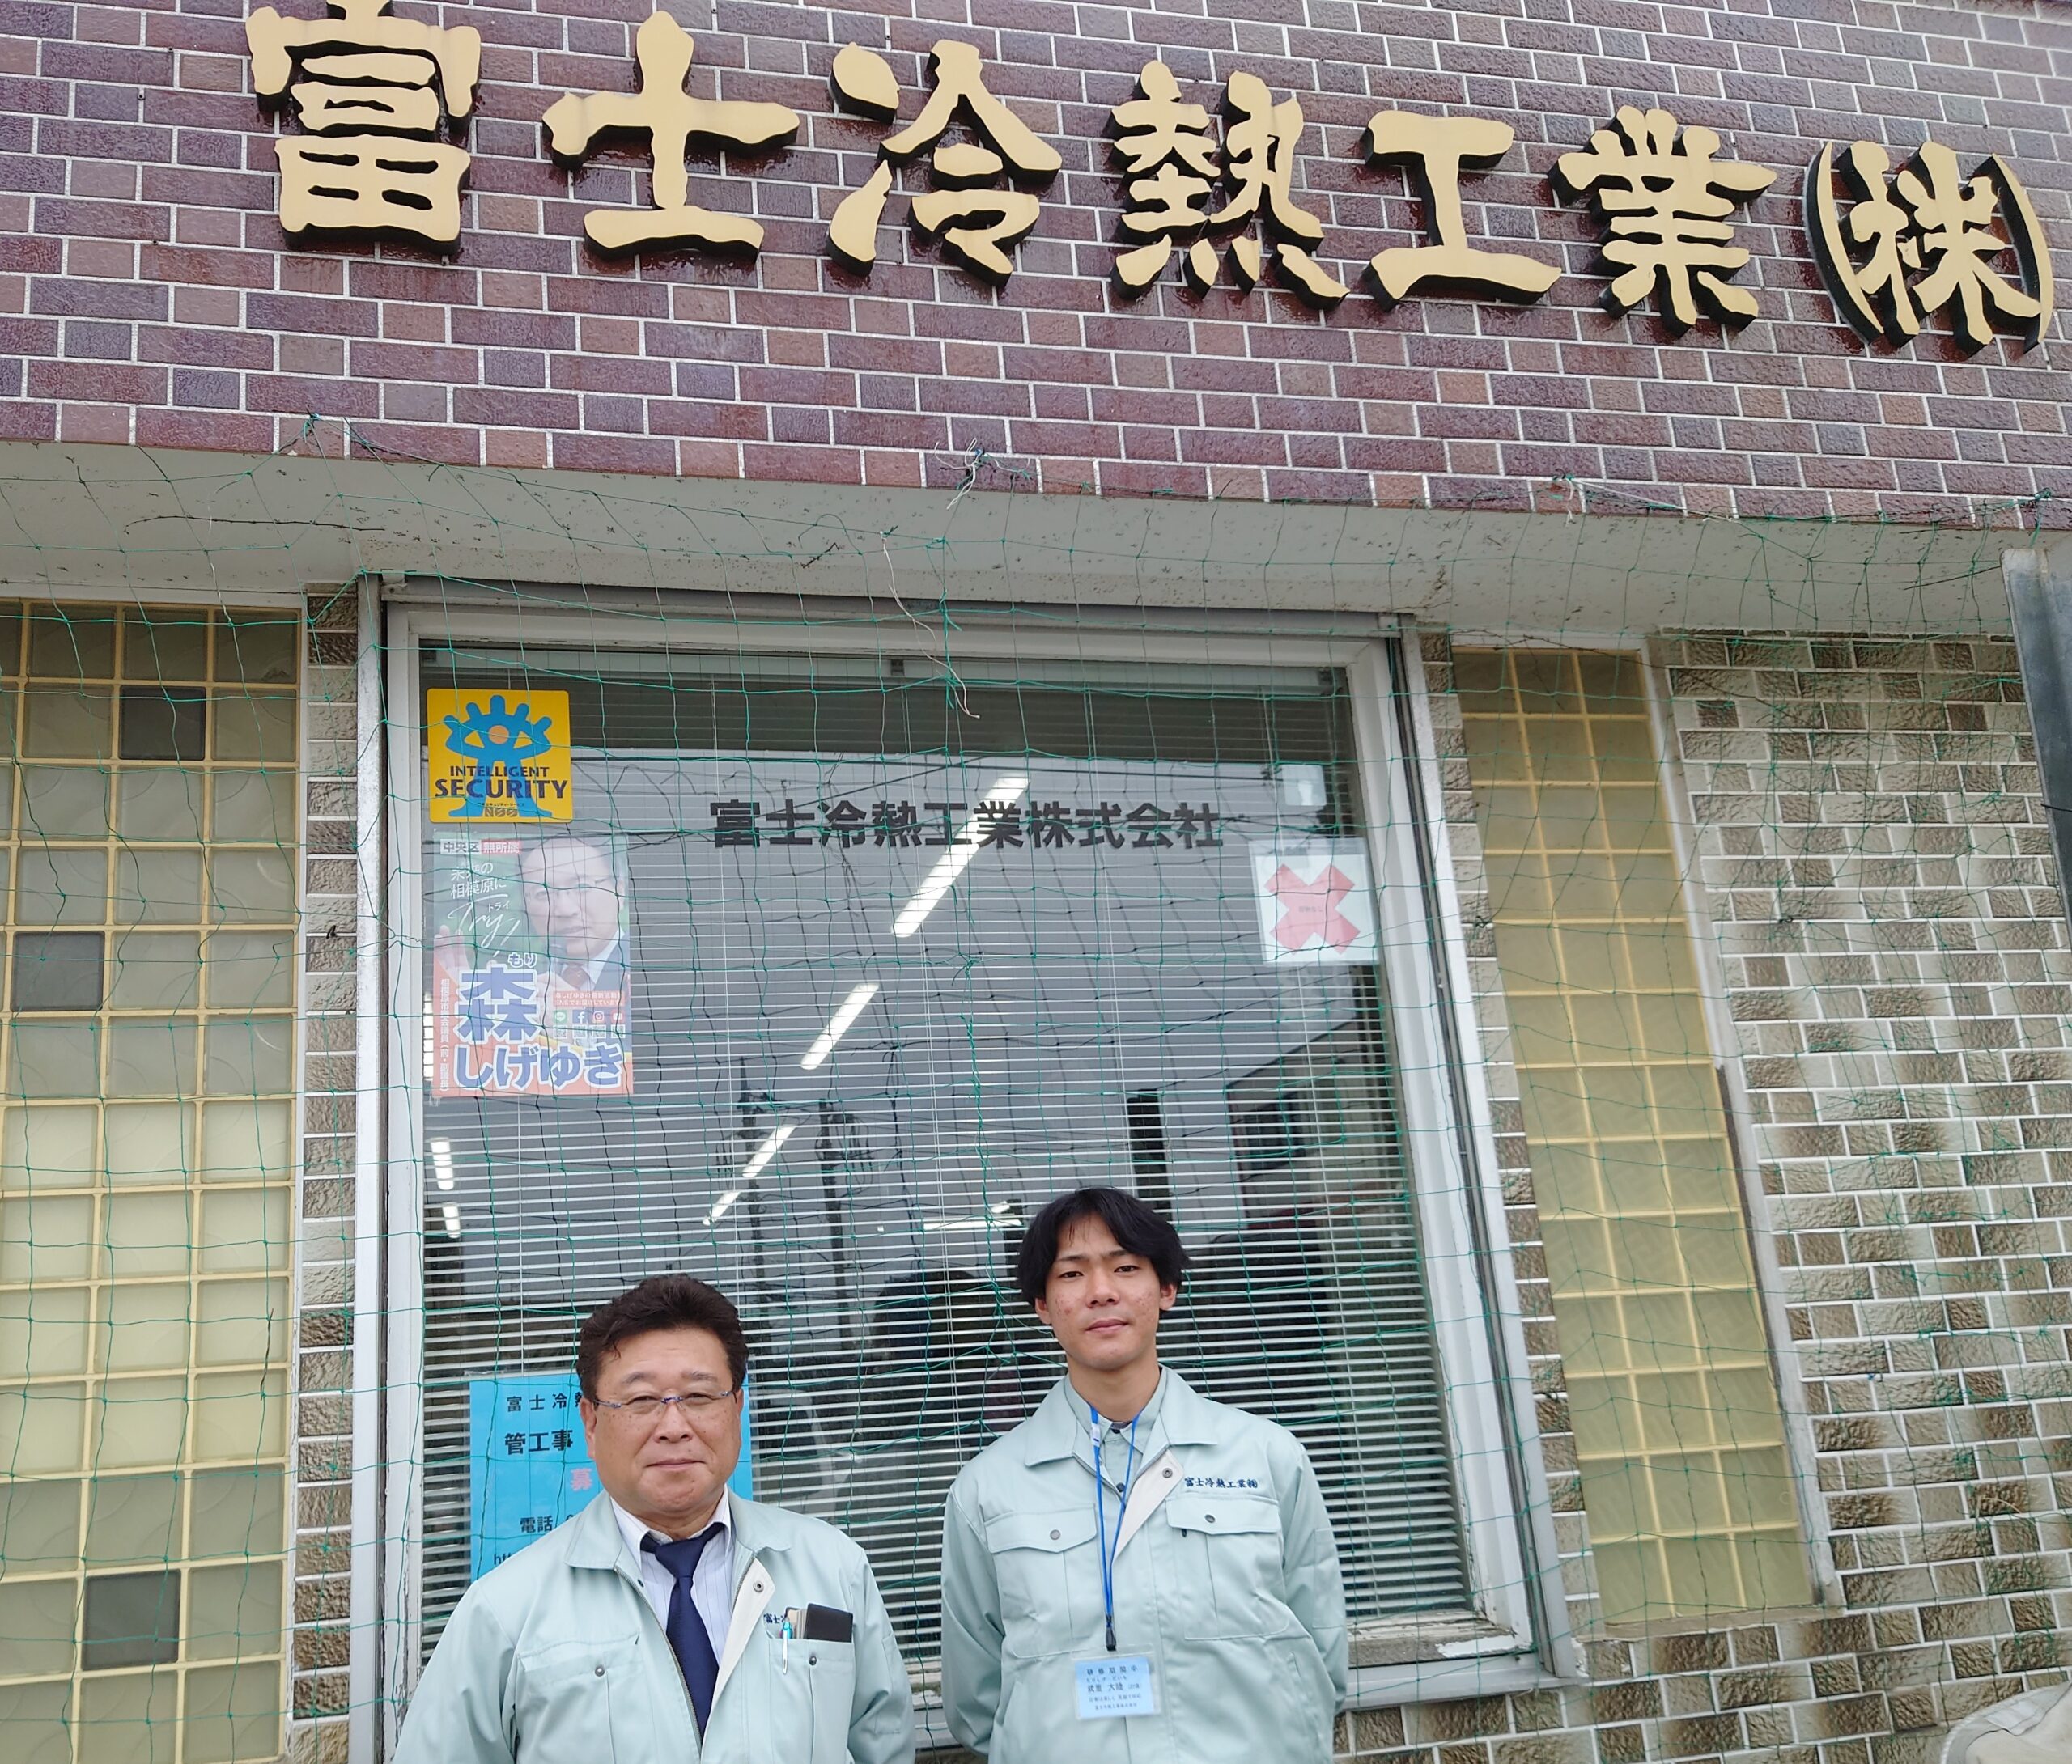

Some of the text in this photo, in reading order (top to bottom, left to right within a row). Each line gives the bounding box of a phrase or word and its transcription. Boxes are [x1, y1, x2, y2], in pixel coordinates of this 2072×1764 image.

[450, 765, 550, 777] INTELLIGENT
[435, 779, 567, 799] SECURITY
[710, 799, 1225, 850] 富士冷熱工業株式会社
[443, 842, 480, 853] 中央区
[450, 877, 507, 900] 相模原に
[488, 900, 511, 913] トライ
[508, 952, 537, 968] もり
[456, 965, 540, 1044] 森
[453, 1040, 623, 1089] しげゆき
[504, 1429, 573, 1456] 管工事
[520, 1515, 553, 1533] 電話
